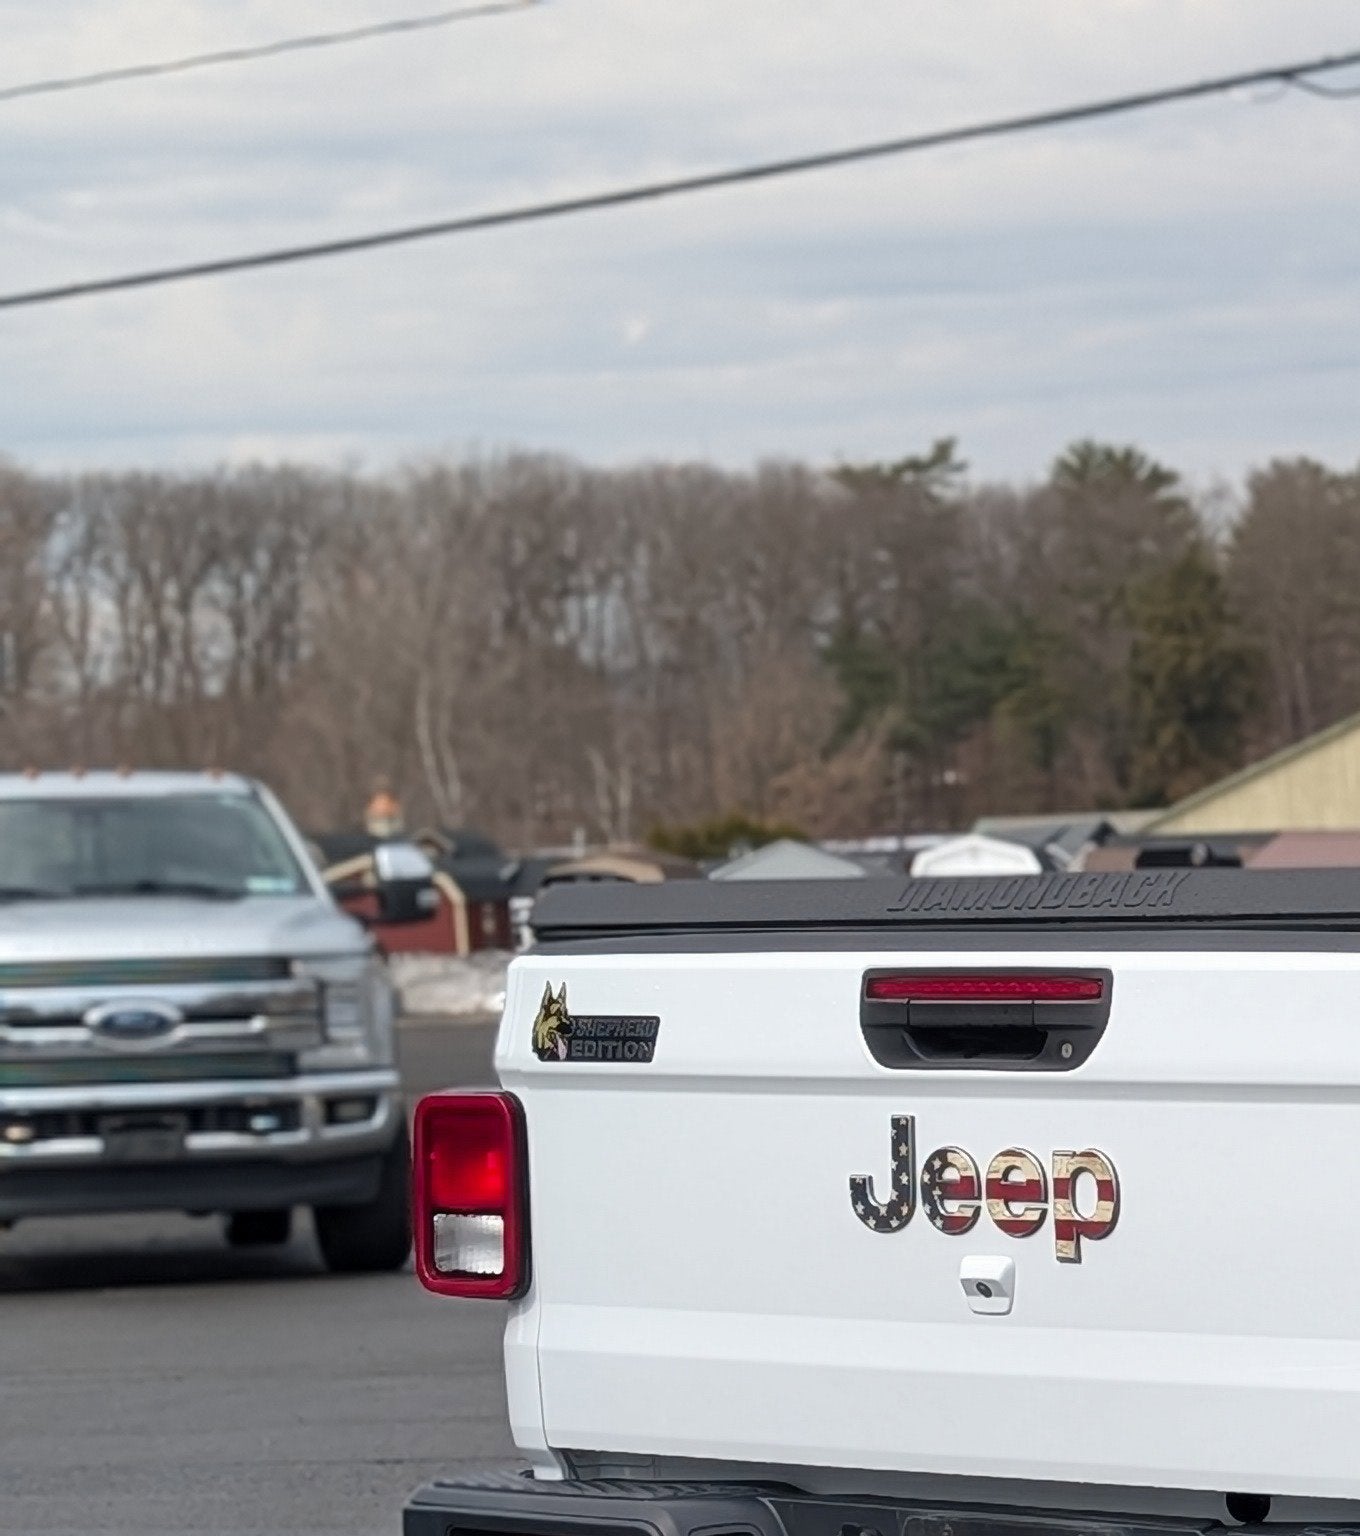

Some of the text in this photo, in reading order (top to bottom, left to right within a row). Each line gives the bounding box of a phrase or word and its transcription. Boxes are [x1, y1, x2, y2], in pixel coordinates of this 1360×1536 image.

[886, 872, 1191, 912] DIAMONDBACK
[570, 1039, 653, 1060] EDITION
[849, 1114, 1121, 1264] Jeep
